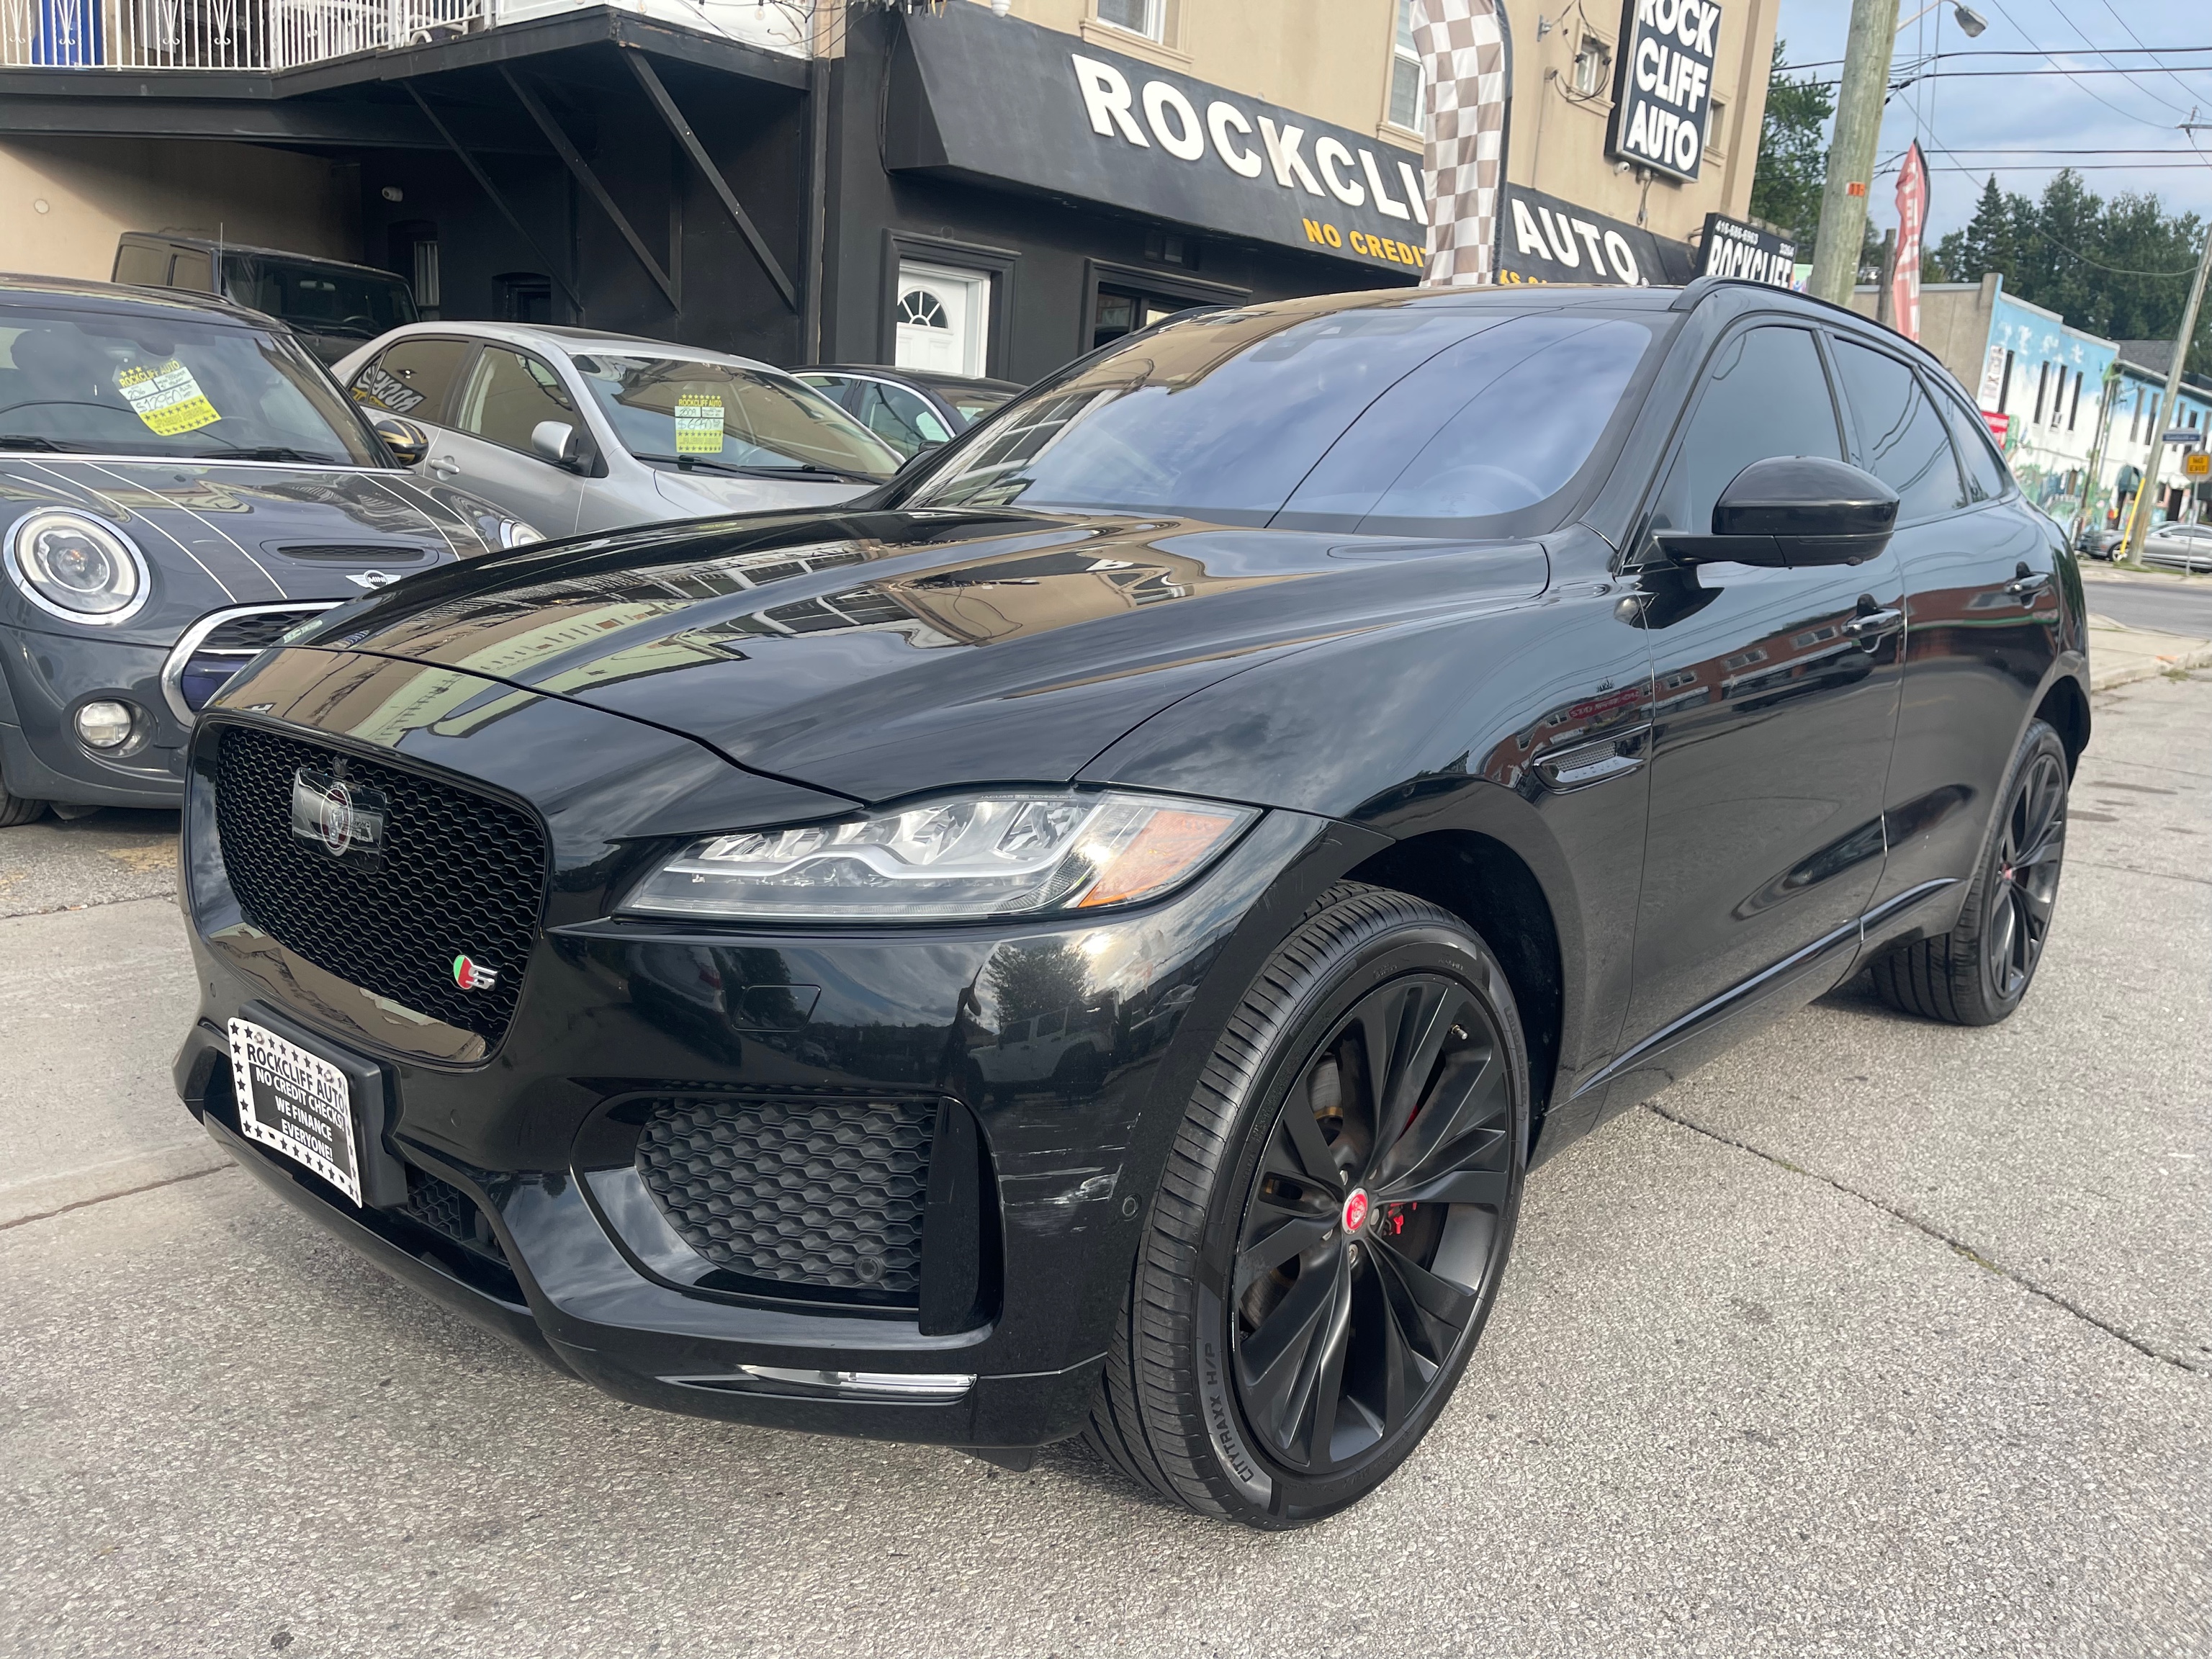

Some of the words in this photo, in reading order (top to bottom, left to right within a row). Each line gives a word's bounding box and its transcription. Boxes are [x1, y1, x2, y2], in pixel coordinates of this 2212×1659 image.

[1636, 37, 1709, 114] CLIFF
[1626, 99, 1699, 171] AUTO
[1071, 53, 1429, 225] ROCKCLI
[1511, 198, 1640, 286] AUTO
[1302, 217, 1342, 248] NO
[119, 369, 159, 388] ROCKCLIFF
[160, 360, 180, 375] AUTO
[678, 398, 708, 407] ROCKCLIFF
[246, 1043, 313, 1092] ROCKCLIFF
[317, 1079, 346, 1112] AUTO
[255, 1068, 272, 1087] NO
[274, 1078, 307, 1106] CREDIT
[308, 1095, 345, 1133] CHECKS!
[275, 1094, 292, 1114] WE
[292, 1104, 333, 1142] FINANCE
[282, 1118, 335, 1163] EVERYONE!
[1205, 1342, 1218, 1385] H/P
[1210, 1394, 1254, 1483] CITYTRAXX
